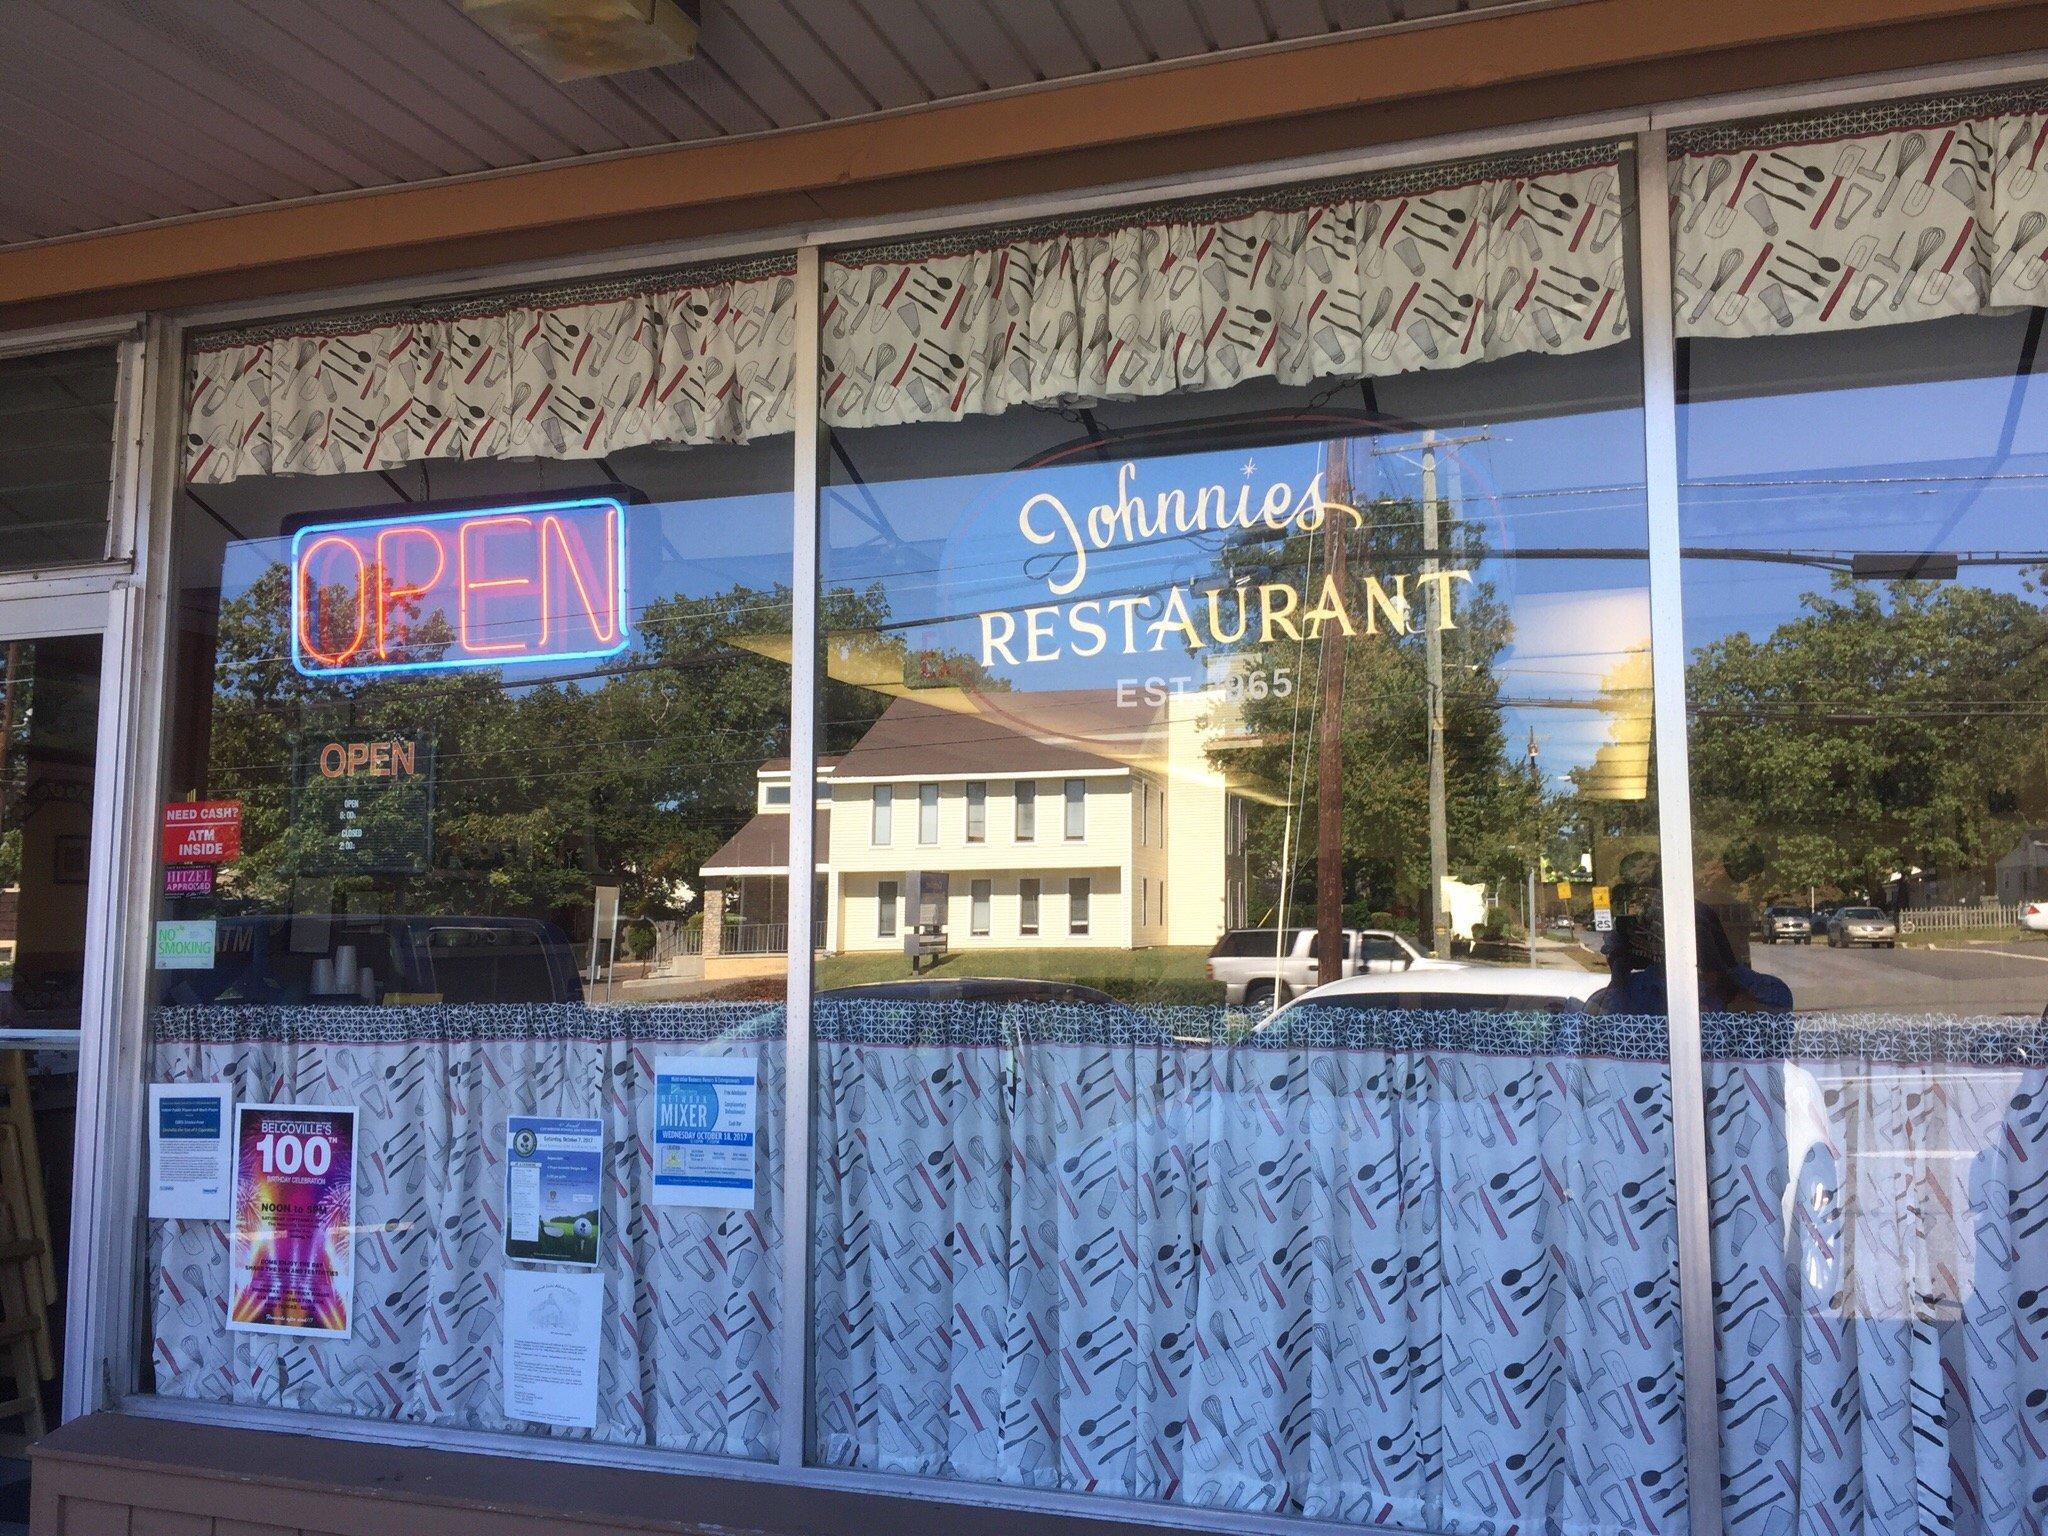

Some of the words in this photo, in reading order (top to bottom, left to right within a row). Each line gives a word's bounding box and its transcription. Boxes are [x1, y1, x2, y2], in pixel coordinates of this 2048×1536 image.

[1019, 462, 1361, 595] Johnnies
[299, 509, 617, 665] OPEN
[979, 570, 1473, 667] RESTAURANT
[320, 741, 415, 778] OPEN
[344, 799, 359, 808] OPEN
[166, 809, 198, 820] NEED
[200, 807, 239, 819] CASH?
[187, 829, 215, 841] ATM
[341, 828, 363, 837] CLOSED
[178, 843, 224, 856] INSIDE
[166, 870, 212, 883] HITZEL
[166, 882, 211, 891] APPROVED
[159, 928, 176, 942] NO
[159, 941, 212, 955] SMOKING
[660, 1103, 707, 1127] MIXER
[261, 1122, 332, 1135] BELCOVILLE'S
[662, 1131, 695, 1139] WEDNESDAY
[696, 1132, 722, 1140] OCTOBER
[734, 1133, 747, 1141] 2017
[266, 1175, 291, 1184] BIRTHDAY
[291, 1176, 326, 1185] CELEBRATION
[261, 1203, 291, 1212] NOON
[294, 1205, 303, 1213] to
